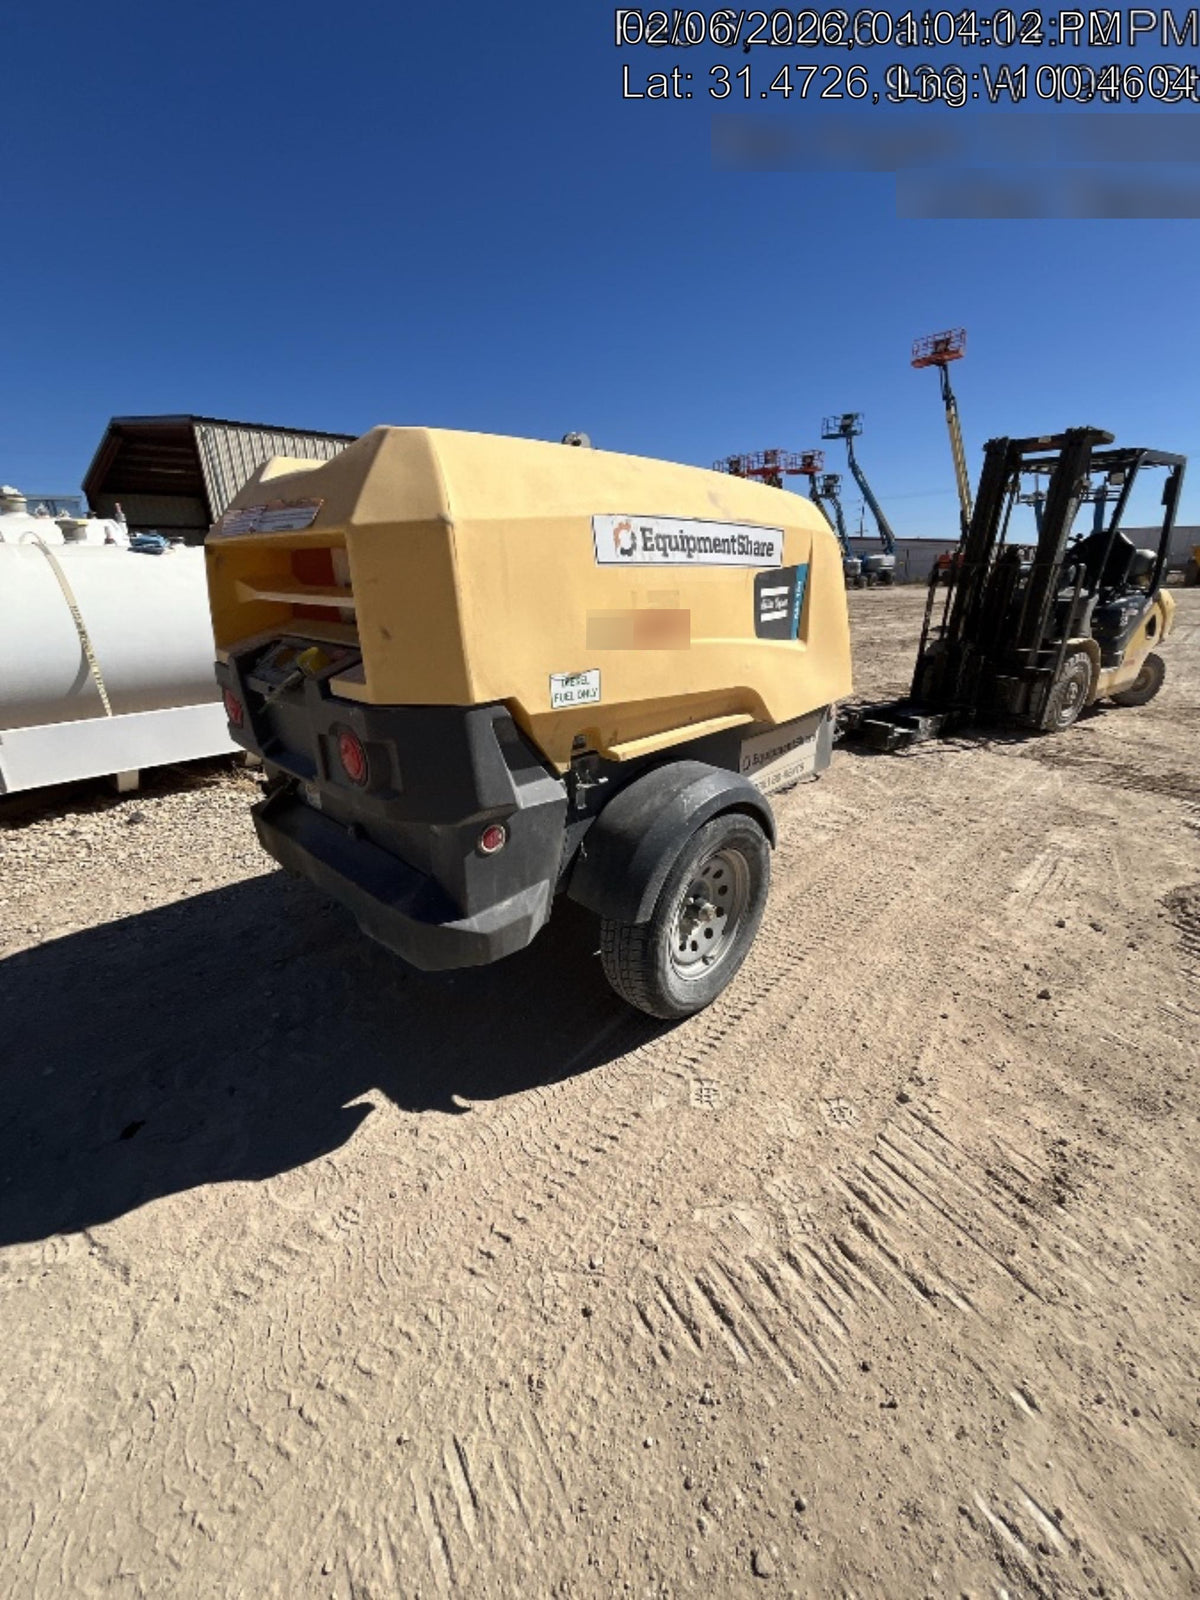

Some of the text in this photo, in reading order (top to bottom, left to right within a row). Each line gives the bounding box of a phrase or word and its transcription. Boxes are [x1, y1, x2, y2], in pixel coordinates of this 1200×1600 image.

[639, 526, 775, 559] EquipmentShare
[554, 687, 598, 703] FUEL ONLY
